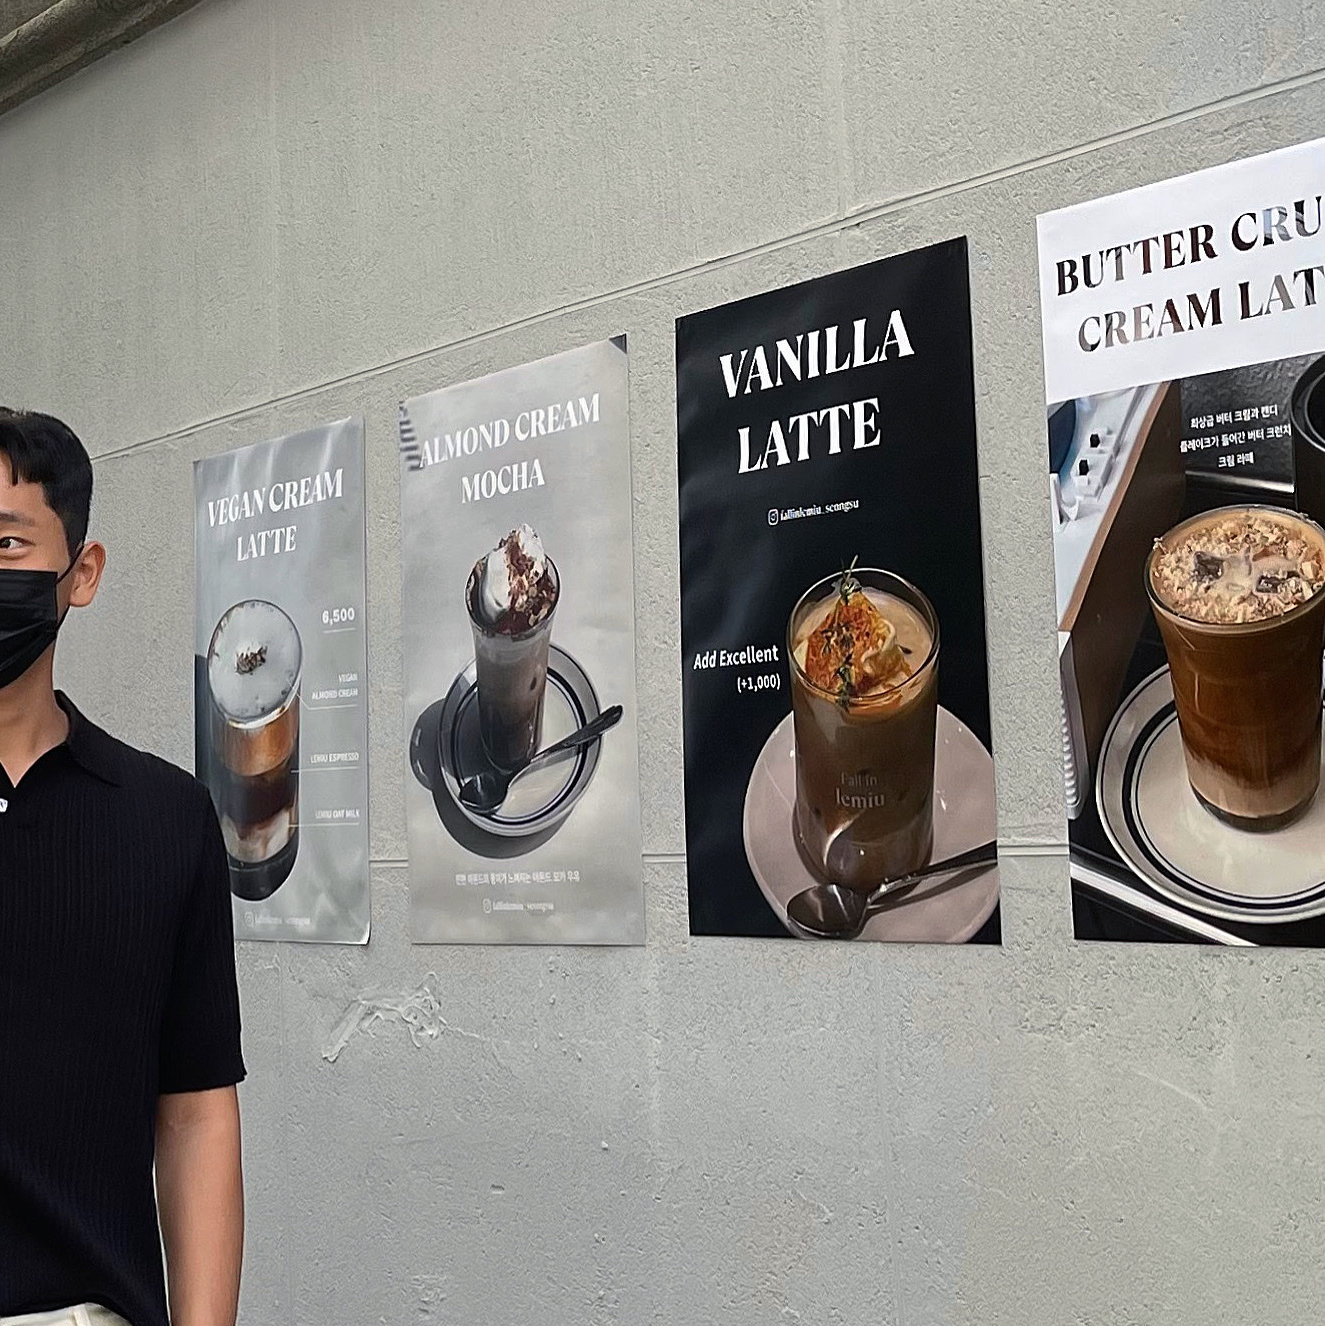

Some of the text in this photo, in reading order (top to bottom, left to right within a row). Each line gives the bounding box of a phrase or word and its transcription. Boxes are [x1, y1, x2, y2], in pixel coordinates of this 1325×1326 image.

[1055, 224, 1219, 296] BUTTER
[1077, 287, 1223, 353] CREAM
[719, 309, 916, 399] VANILLA
[419, 393, 600, 469] ALMOND CREAM
[737, 397, 882, 474] LATTE
[208, 468, 343, 527] VEGAN CREAM
[460, 458, 546, 504] MOCHA
[237, 525, 297, 561] LATTE
[322, 607, 355, 626] 6,500
[693, 645, 779, 670] Add Excellent
[737, 673, 781, 693] (+1,000)
[835, 787, 885, 808] lemiu
